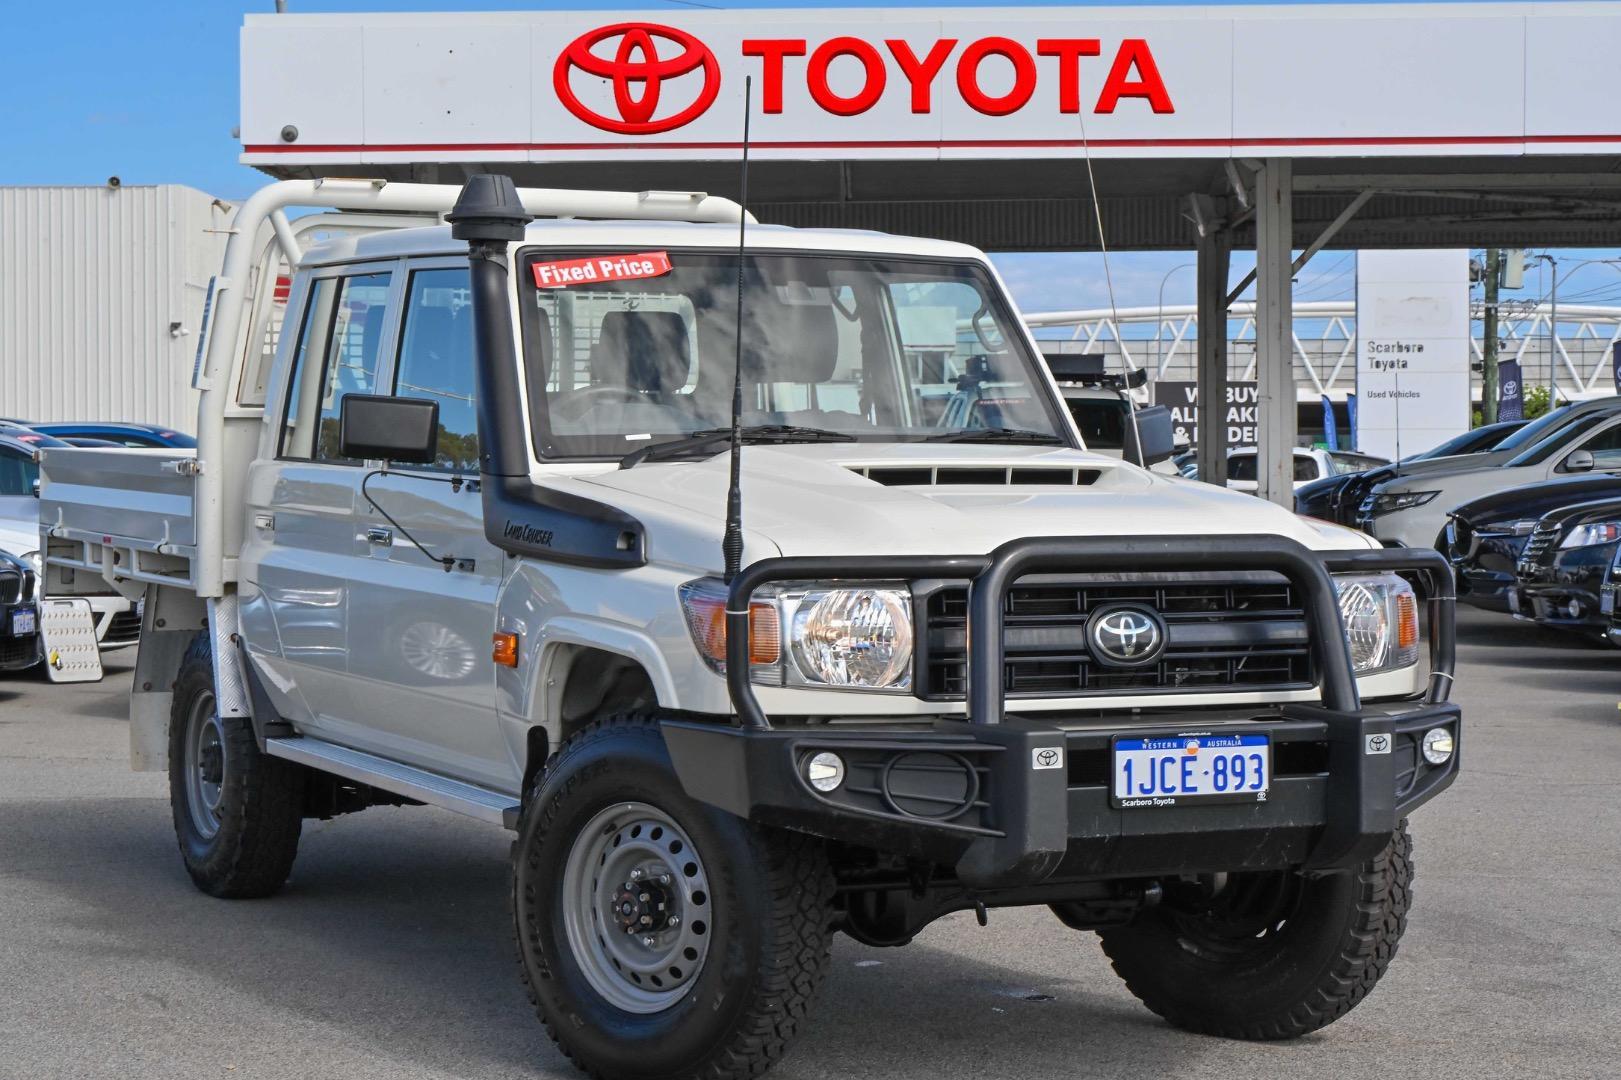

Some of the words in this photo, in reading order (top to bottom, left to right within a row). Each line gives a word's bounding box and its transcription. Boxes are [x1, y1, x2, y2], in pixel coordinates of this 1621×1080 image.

[742, 36, 1175, 116] TOYOTA
[538, 262, 597, 283] Fixed
[598, 258, 655, 278] Price
[1367, 357, 1408, 372] Toyota
[1367, 390, 1386, 398] Used
[1388, 390, 1421, 398] Vehicles
[1142, 741, 1177, 749] WESTERN
[1207, 739, 1242, 747] AUSTRALIA
[1121, 798, 1152, 807] Scarboro
[1153, 797, 1176, 807] Toyota
